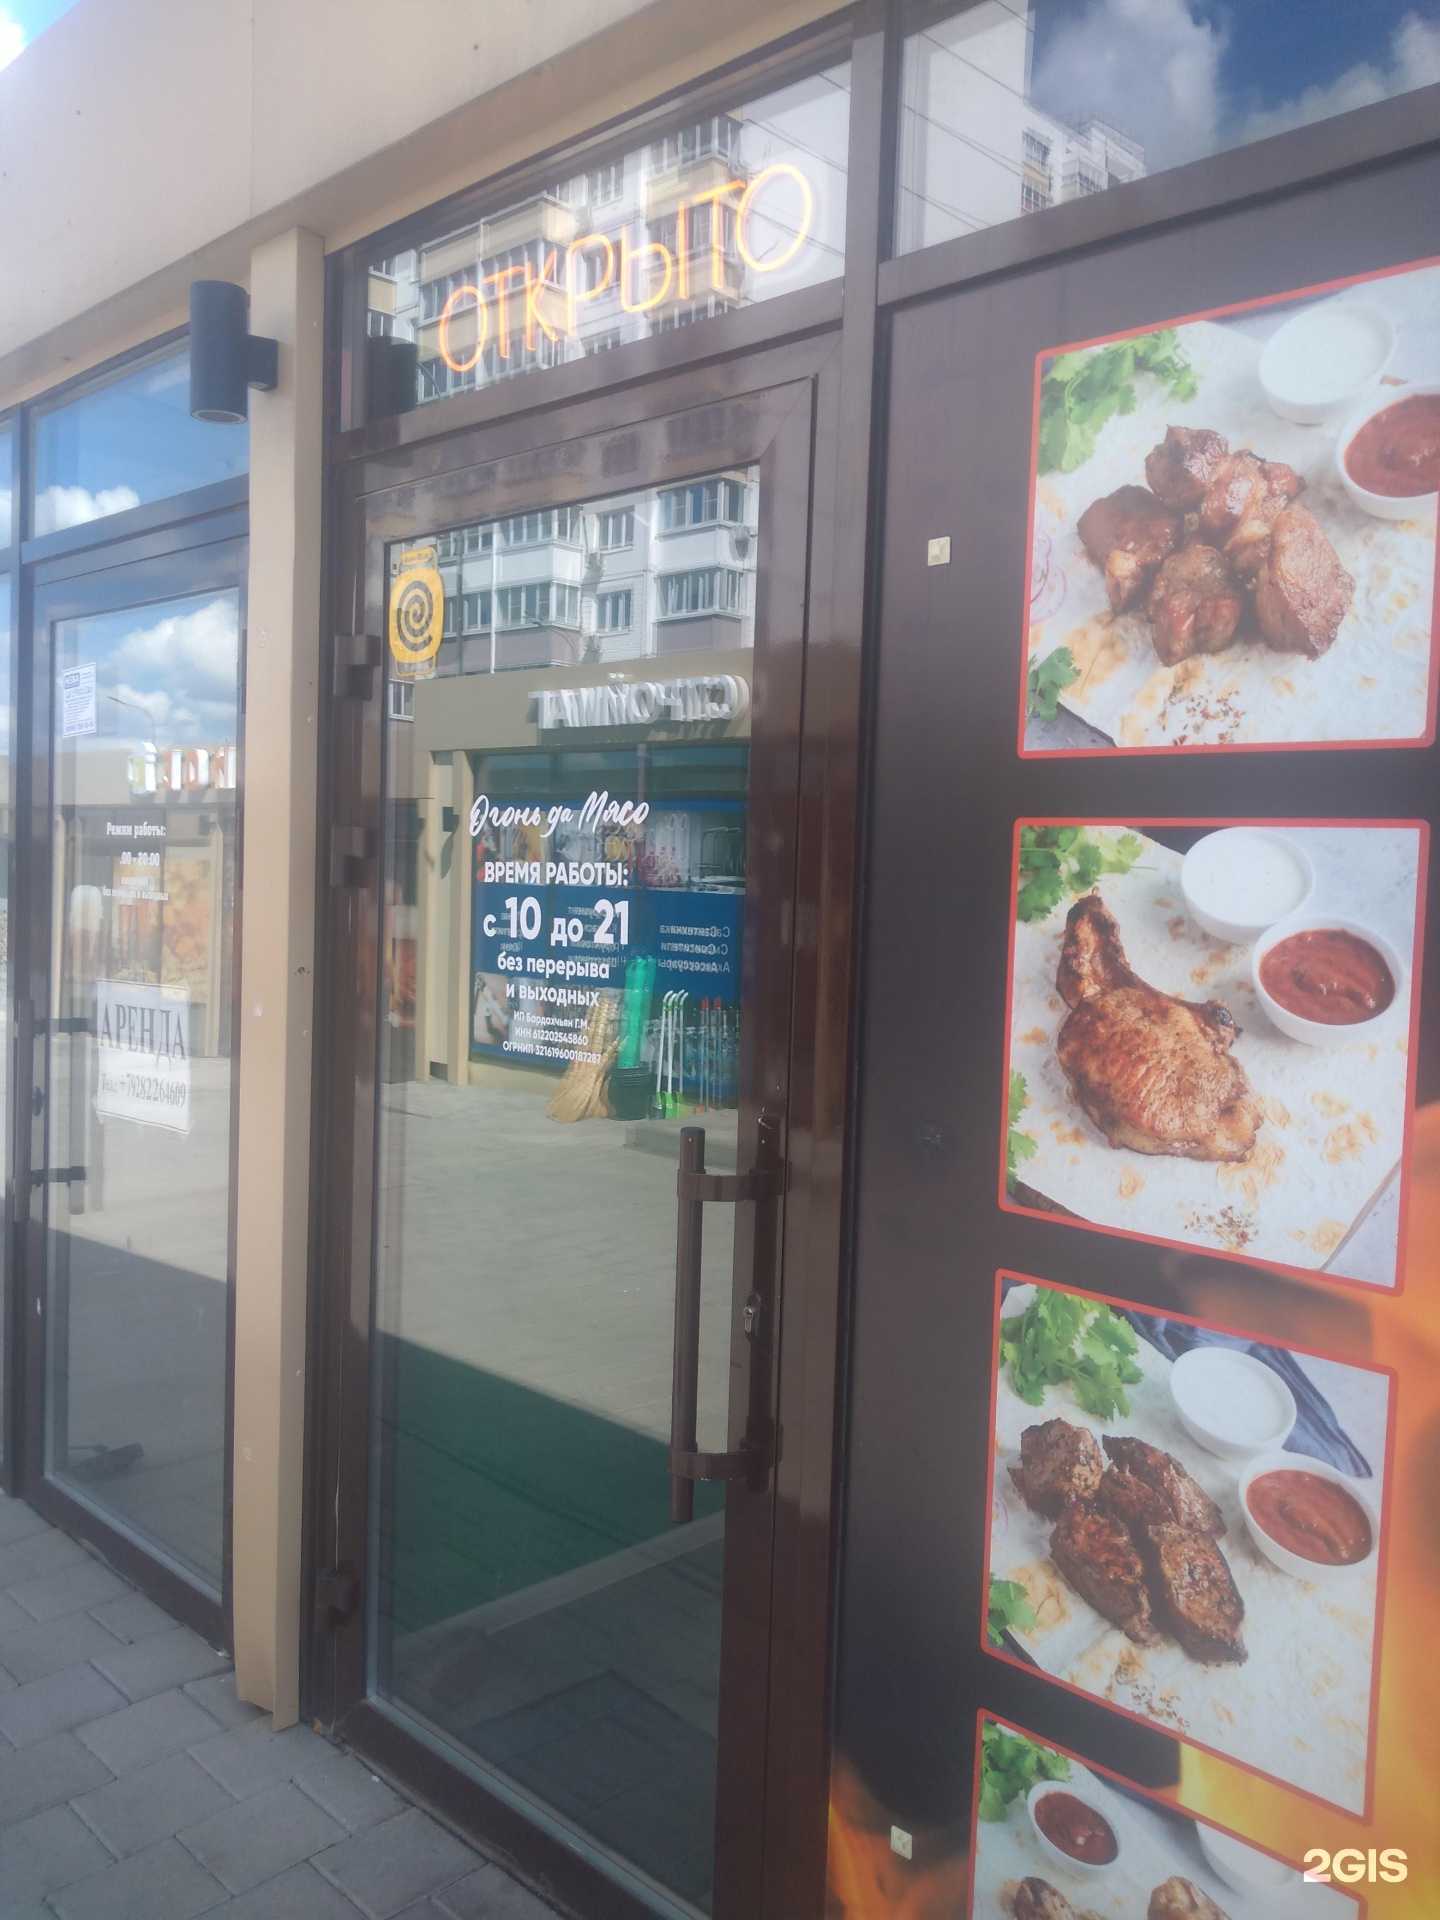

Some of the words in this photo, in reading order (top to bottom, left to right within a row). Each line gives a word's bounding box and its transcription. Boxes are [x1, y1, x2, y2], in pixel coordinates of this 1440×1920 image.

[438, 163, 815, 373] ОТКРЫТО
[469, 794, 541, 838] Огонь
[541, 806, 574, 838] да
[575, 790, 650, 831] Мясо
[484, 861, 541, 885] ВРЕМЯ
[545, 862, 629, 887] РАБОТЫ:
[483, 915, 497, 938] с
[505, 896, 542, 941] 10
[550, 916, 584, 948] до
[593, 898, 630, 946] 21
[497, 951, 523, 971] без
[526, 957, 610, 981] перерыва
[506, 984, 516, 999] и
[519, 986, 600, 1008] выходных
[100, 1003, 186, 1071] АРЕНДА
[502, 1041, 534, 1055] ОГРНИП
[515, 1027, 532, 1039] ИНН
[532, 1029, 589, 1047] 612202545860
